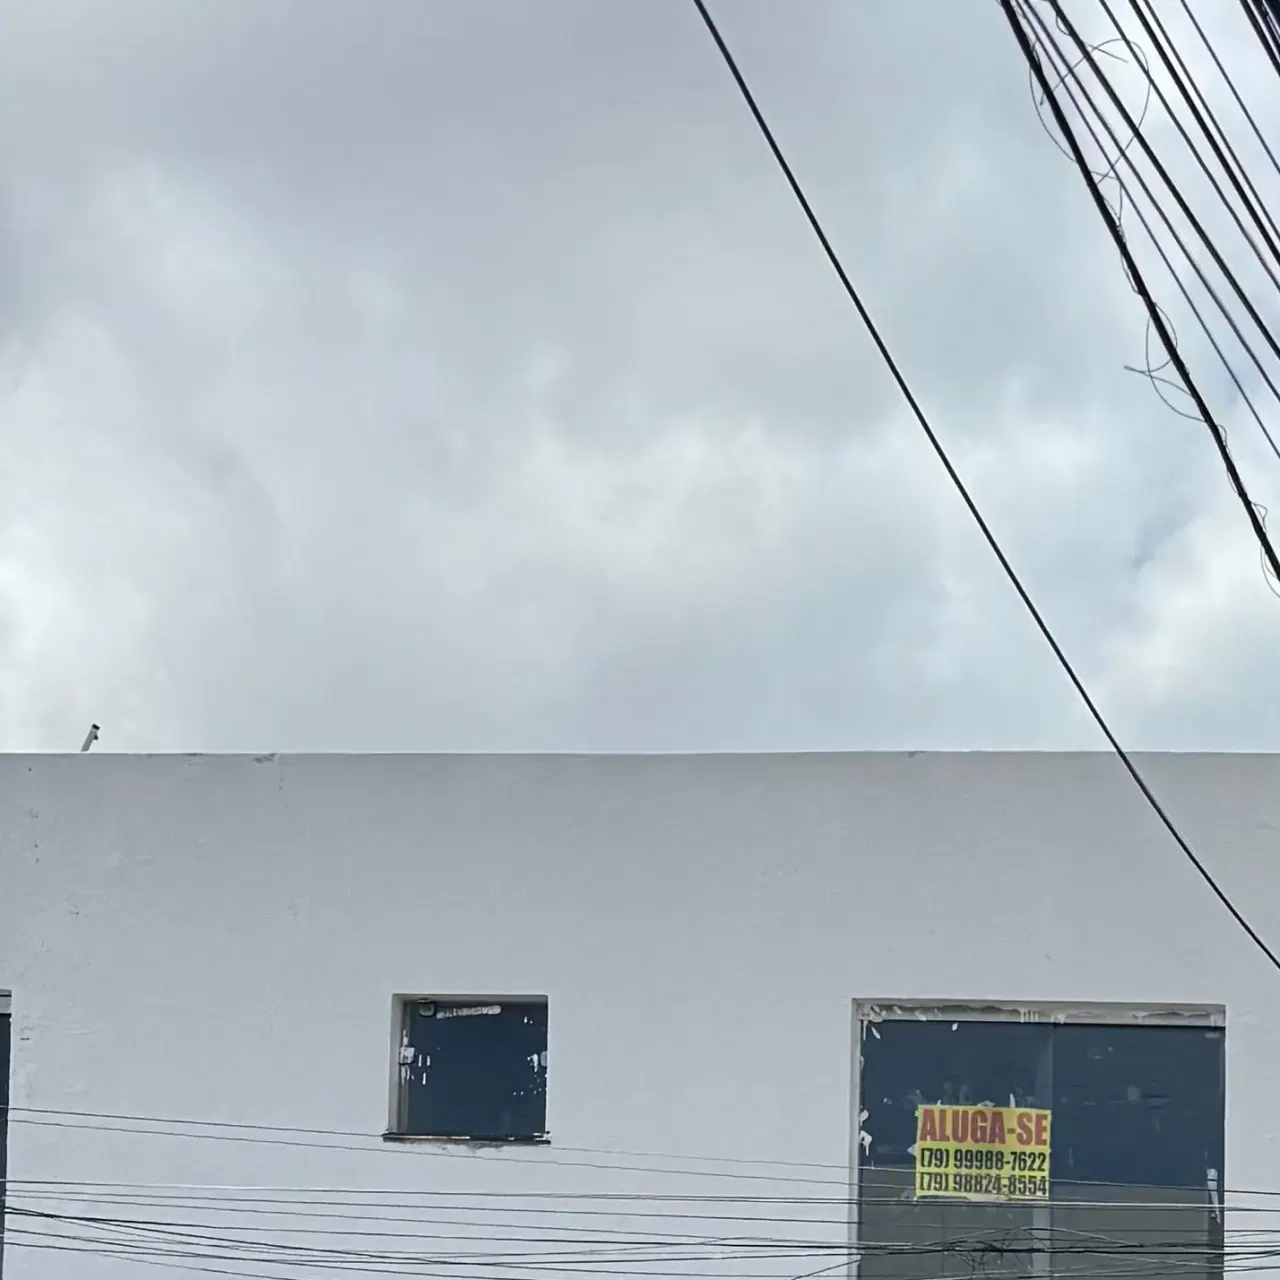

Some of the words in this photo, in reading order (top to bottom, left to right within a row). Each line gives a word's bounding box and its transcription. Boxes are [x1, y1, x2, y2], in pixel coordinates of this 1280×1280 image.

[919, 1108, 1049, 1146] ALUGA-SE
[920, 1147, 949, 1168] (79)
[953, 1149, 1047, 1172] 99988-7622
[919, 1172, 949, 1191] (79)
[953, 1174, 1048, 1195] 98824-8554
